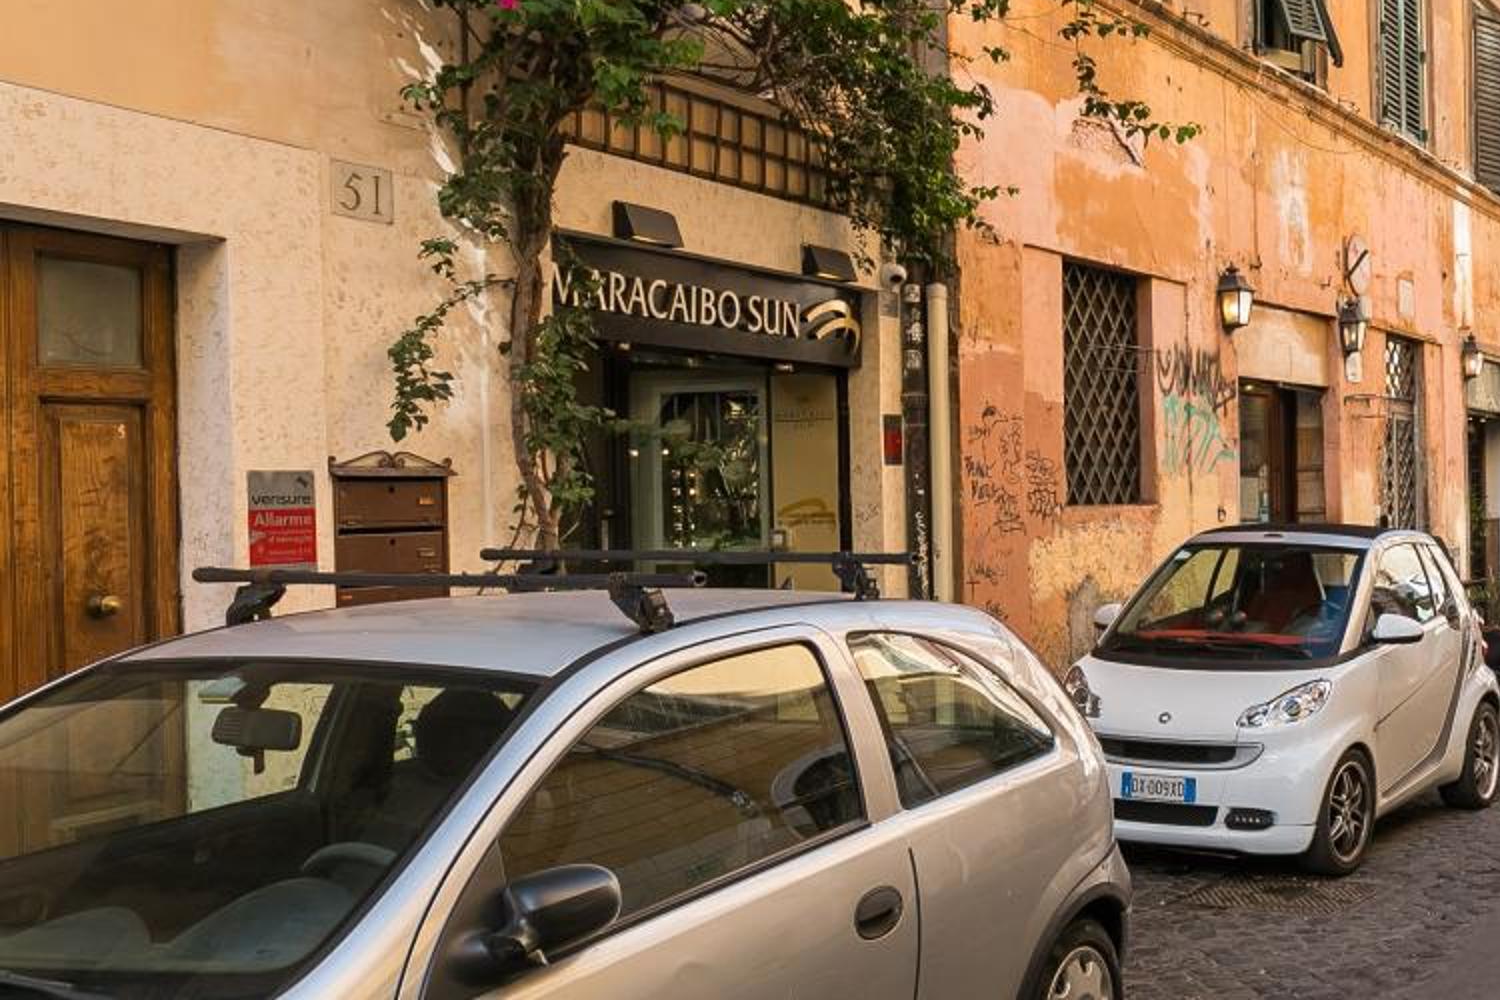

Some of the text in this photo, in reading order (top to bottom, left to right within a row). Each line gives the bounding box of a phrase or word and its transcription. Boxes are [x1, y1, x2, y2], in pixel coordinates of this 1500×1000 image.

[338, 172, 383, 216] 51
[748, 295, 800, 339] SUN
[251, 493, 312, 506] verisure
[254, 511, 313, 528] Allarme
